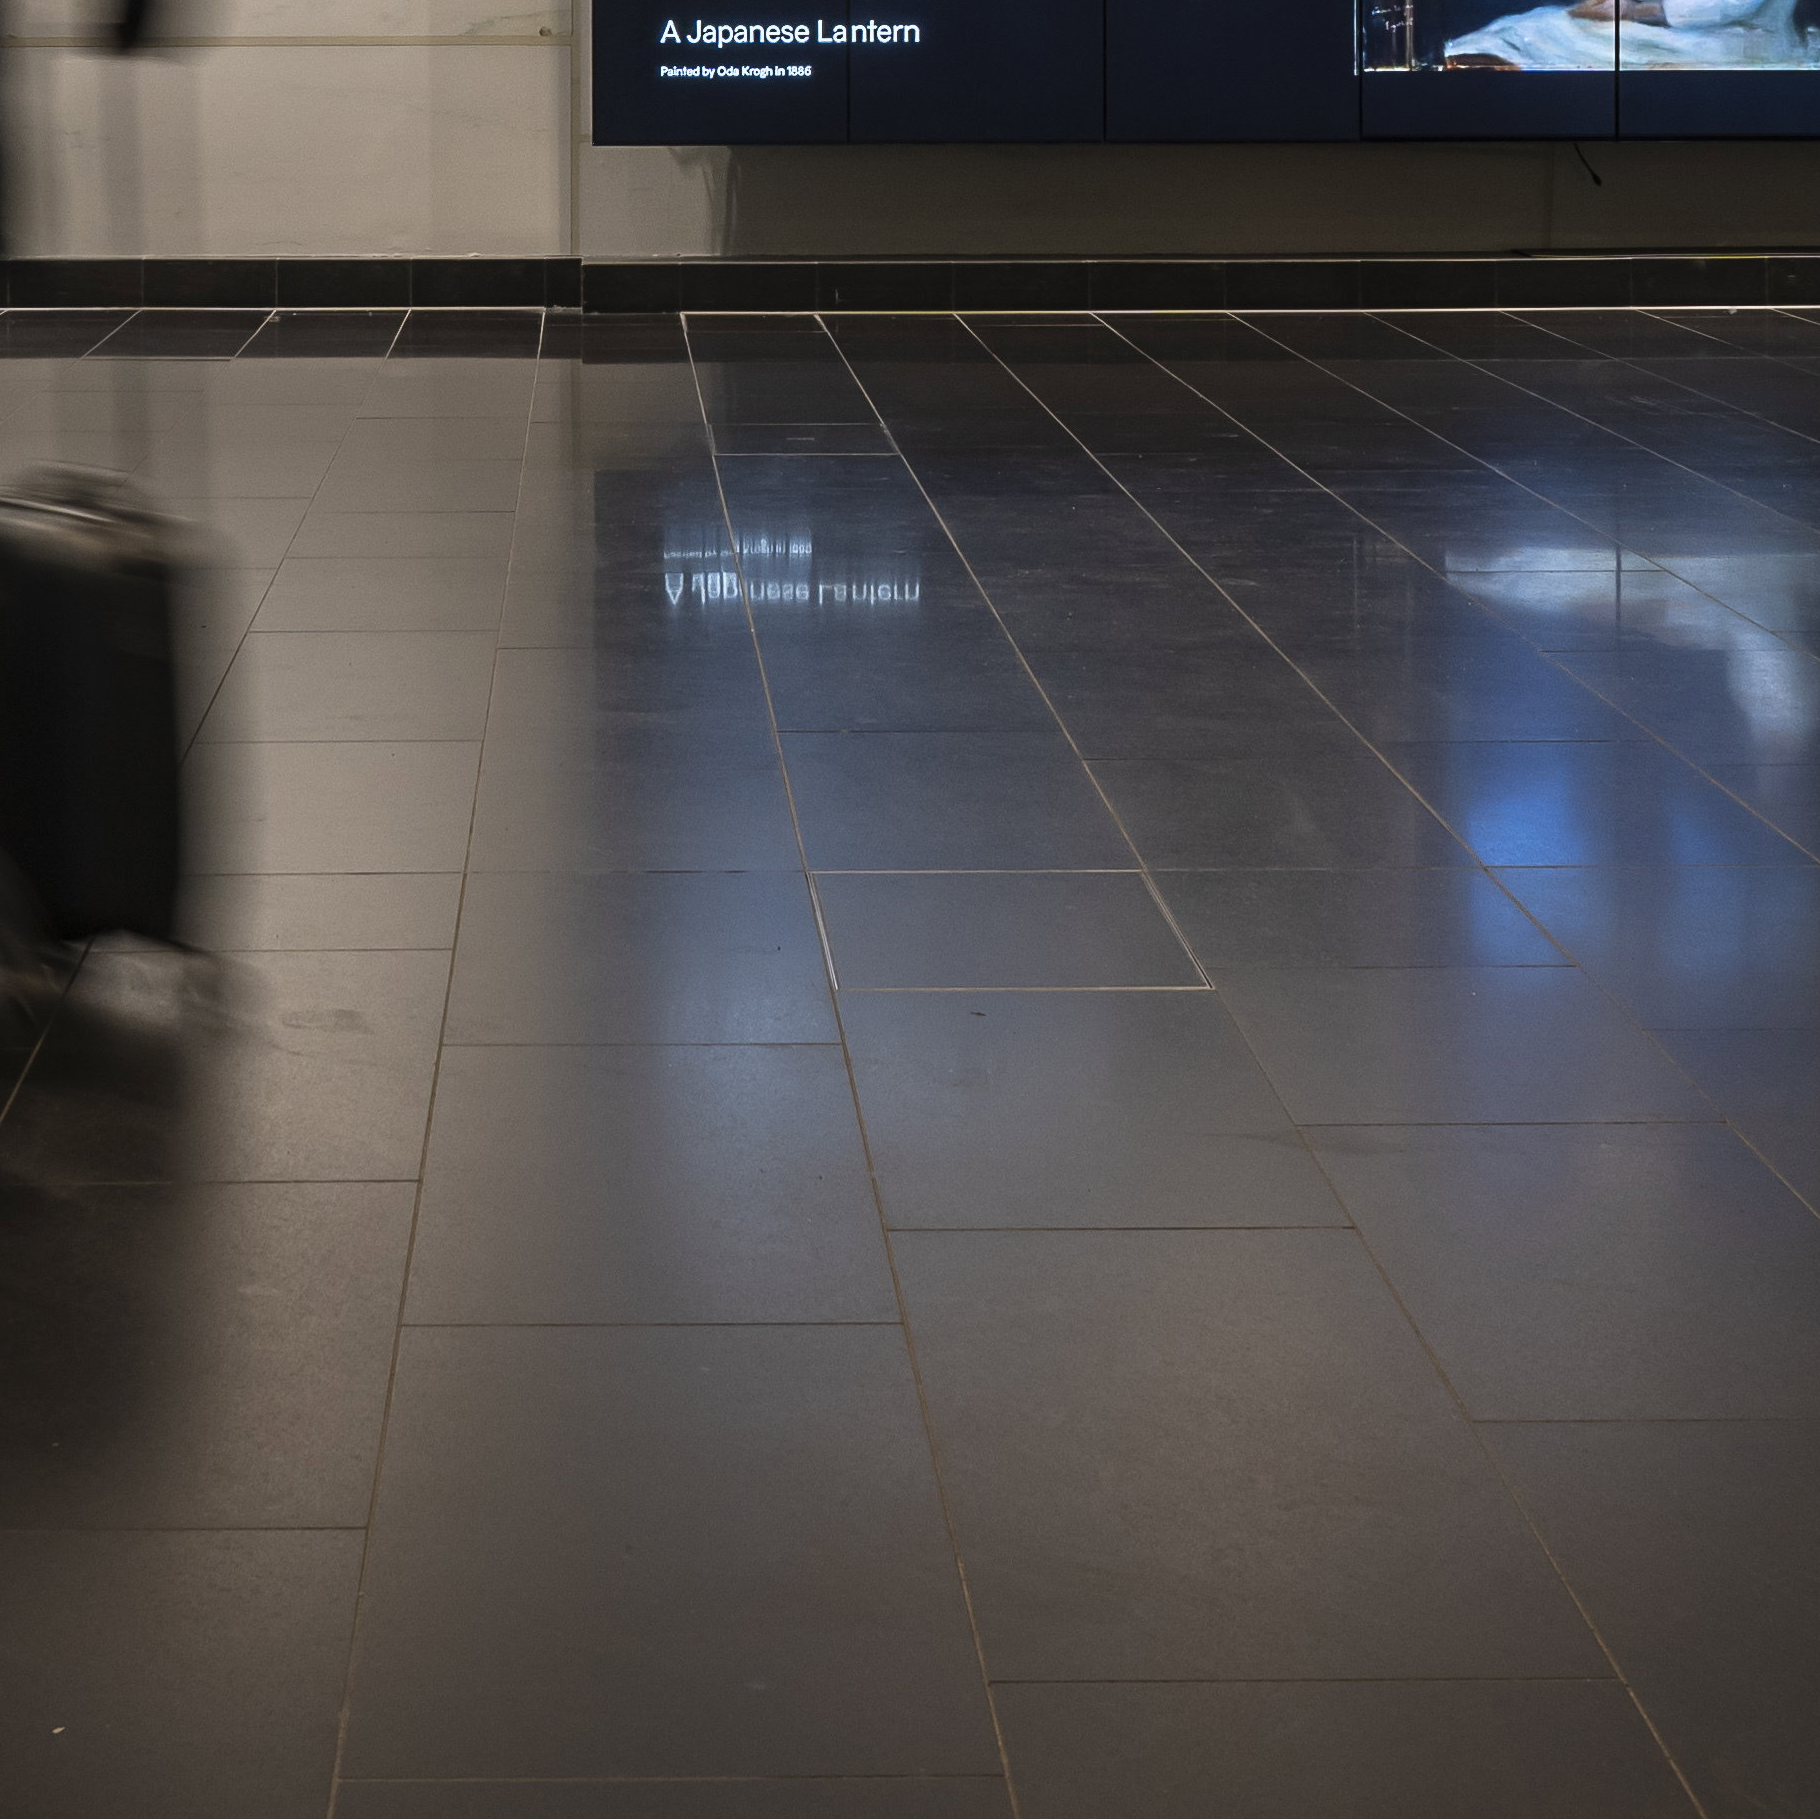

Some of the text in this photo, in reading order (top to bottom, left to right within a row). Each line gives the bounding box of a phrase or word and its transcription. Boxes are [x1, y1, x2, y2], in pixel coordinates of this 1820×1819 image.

[659, 19, 921, 49] A Japanese Lantern
[660, 65, 701, 77] Painted
[702, 65, 716, 79] by
[741, 65, 774, 79] Krogh
[775, 65, 786, 77] in
